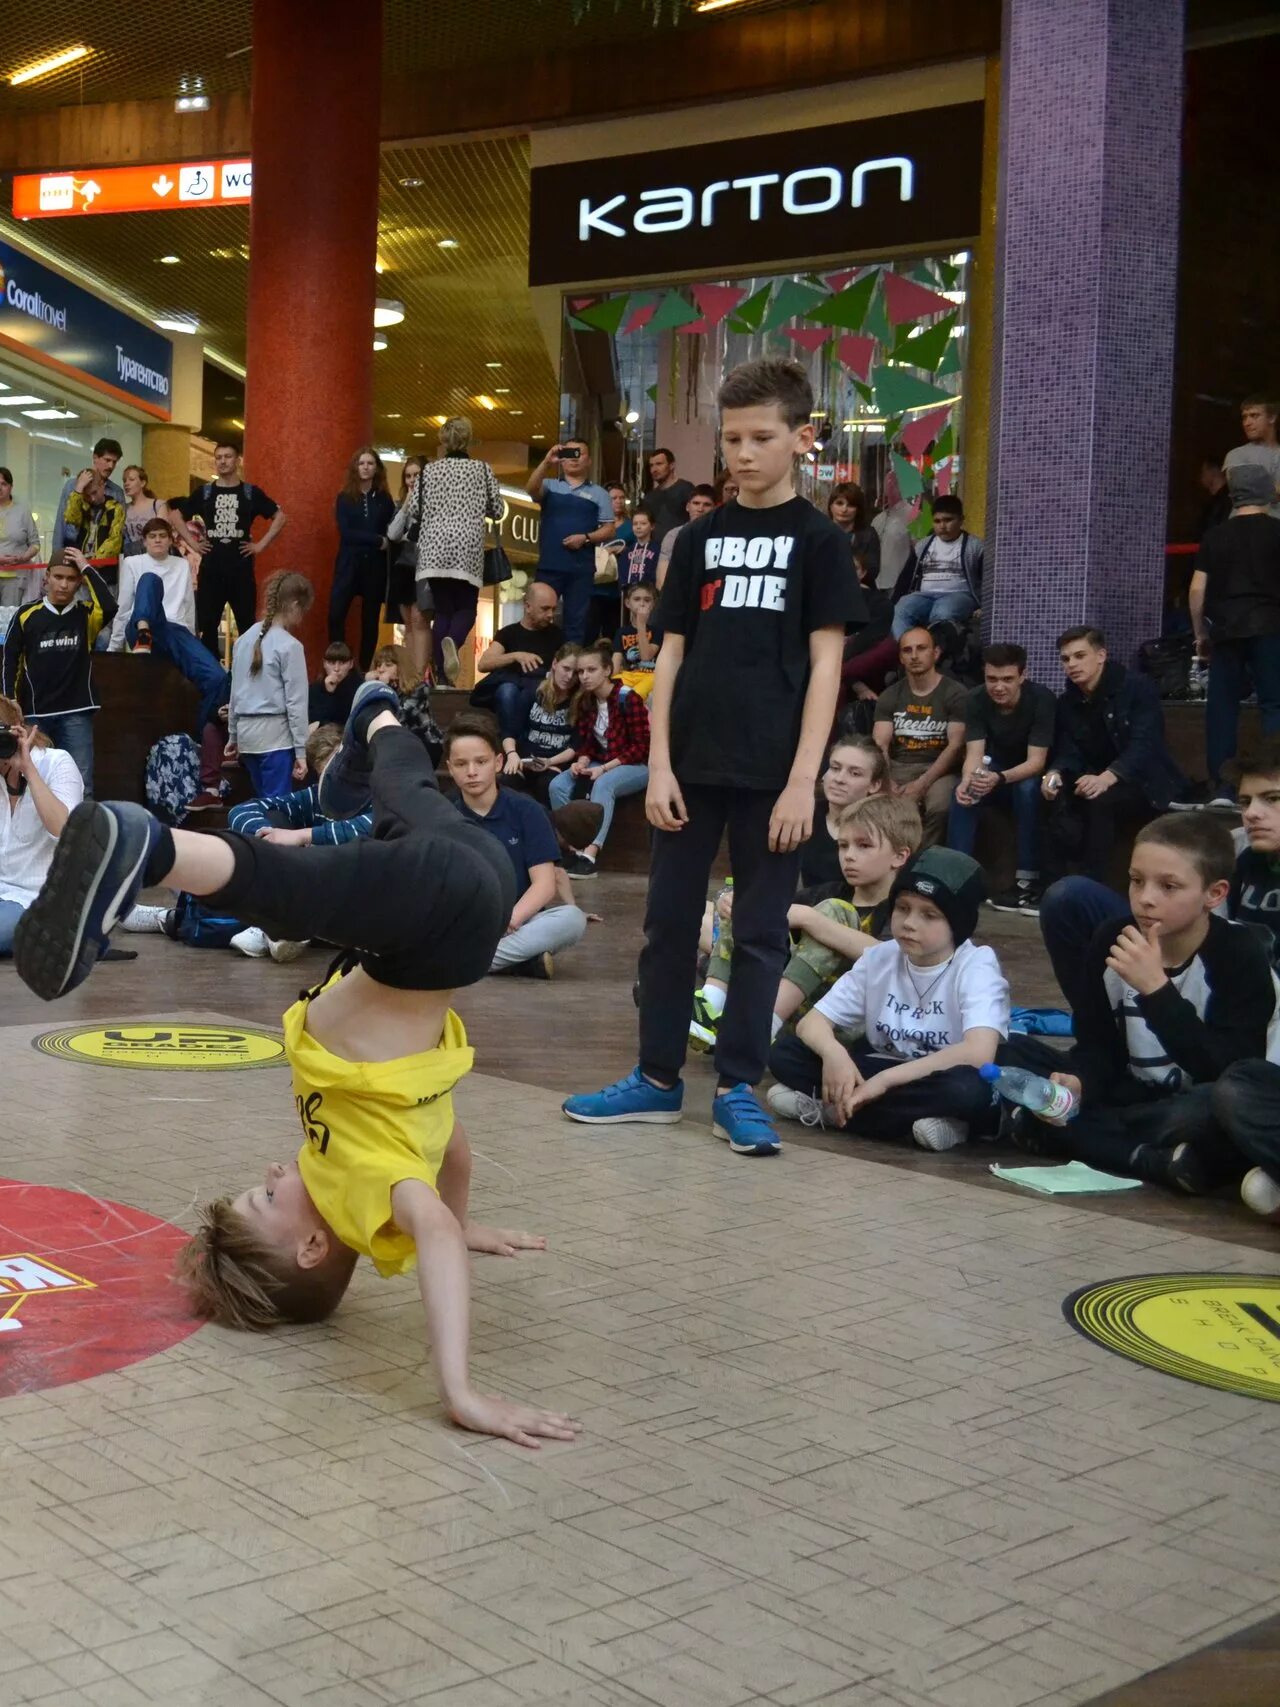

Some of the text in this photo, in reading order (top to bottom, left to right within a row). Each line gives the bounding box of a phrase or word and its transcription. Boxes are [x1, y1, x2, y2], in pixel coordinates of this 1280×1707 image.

[115, 344, 170, 396] Турагентство
[511, 515, 539, 543] CLU
[704, 536, 795, 570] BBOY
[720, 575, 787, 612] DIE
[39, 635, 79, 649] we win!
[911, 1000, 944, 1019] RCK
